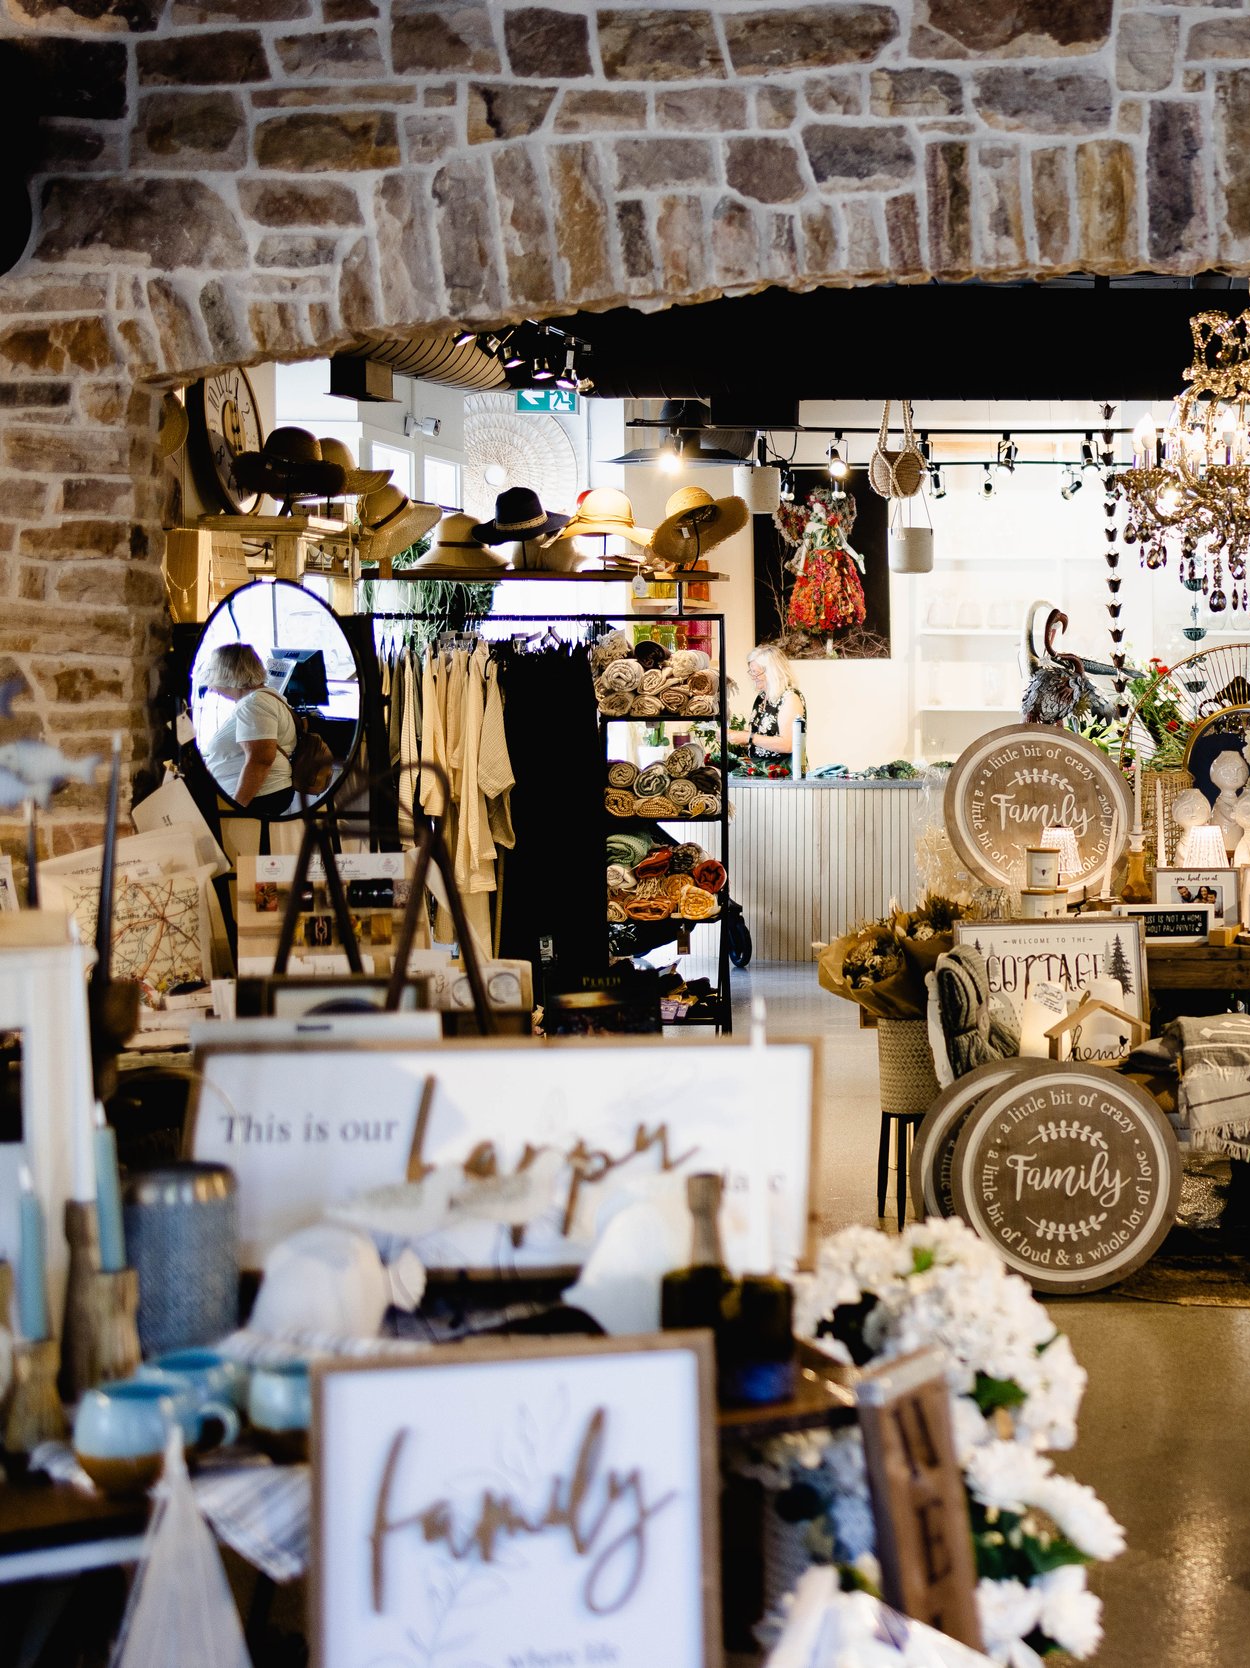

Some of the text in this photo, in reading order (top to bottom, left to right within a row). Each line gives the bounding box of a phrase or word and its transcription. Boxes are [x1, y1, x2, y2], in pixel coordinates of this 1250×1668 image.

[982, 745, 1097, 782] a little bit of crazy
[971, 789, 1008, 864] a little bit of
[990, 793, 1096, 838] Family
[1091, 838, 1108, 856] lot
[1188, 873, 1200, 882] had
[129, 926, 150, 934] Perth
[1157, 915, 1164, 924] IS
[1166, 914, 1179, 923] NOT
[1181, 914, 1186, 922] A
[1187, 914, 1202, 922] HOME
[1163, 924, 1175, 933] PAW
[1176, 924, 1195, 932] PRINTS
[1011, 936, 1051, 945] WELCOME
[986, 952, 1106, 1000] COTTAGE
[1068, 1024, 1132, 1063] home
[221, 1112, 401, 1144] This is our
[1000, 1089, 1138, 1135] a little bit of crazy
[1006, 1150, 1132, 1208] Family
[982, 1149, 1152, 1266] a little bit of loud & a whole lot of love
[367, 1402, 679, 1616] family
